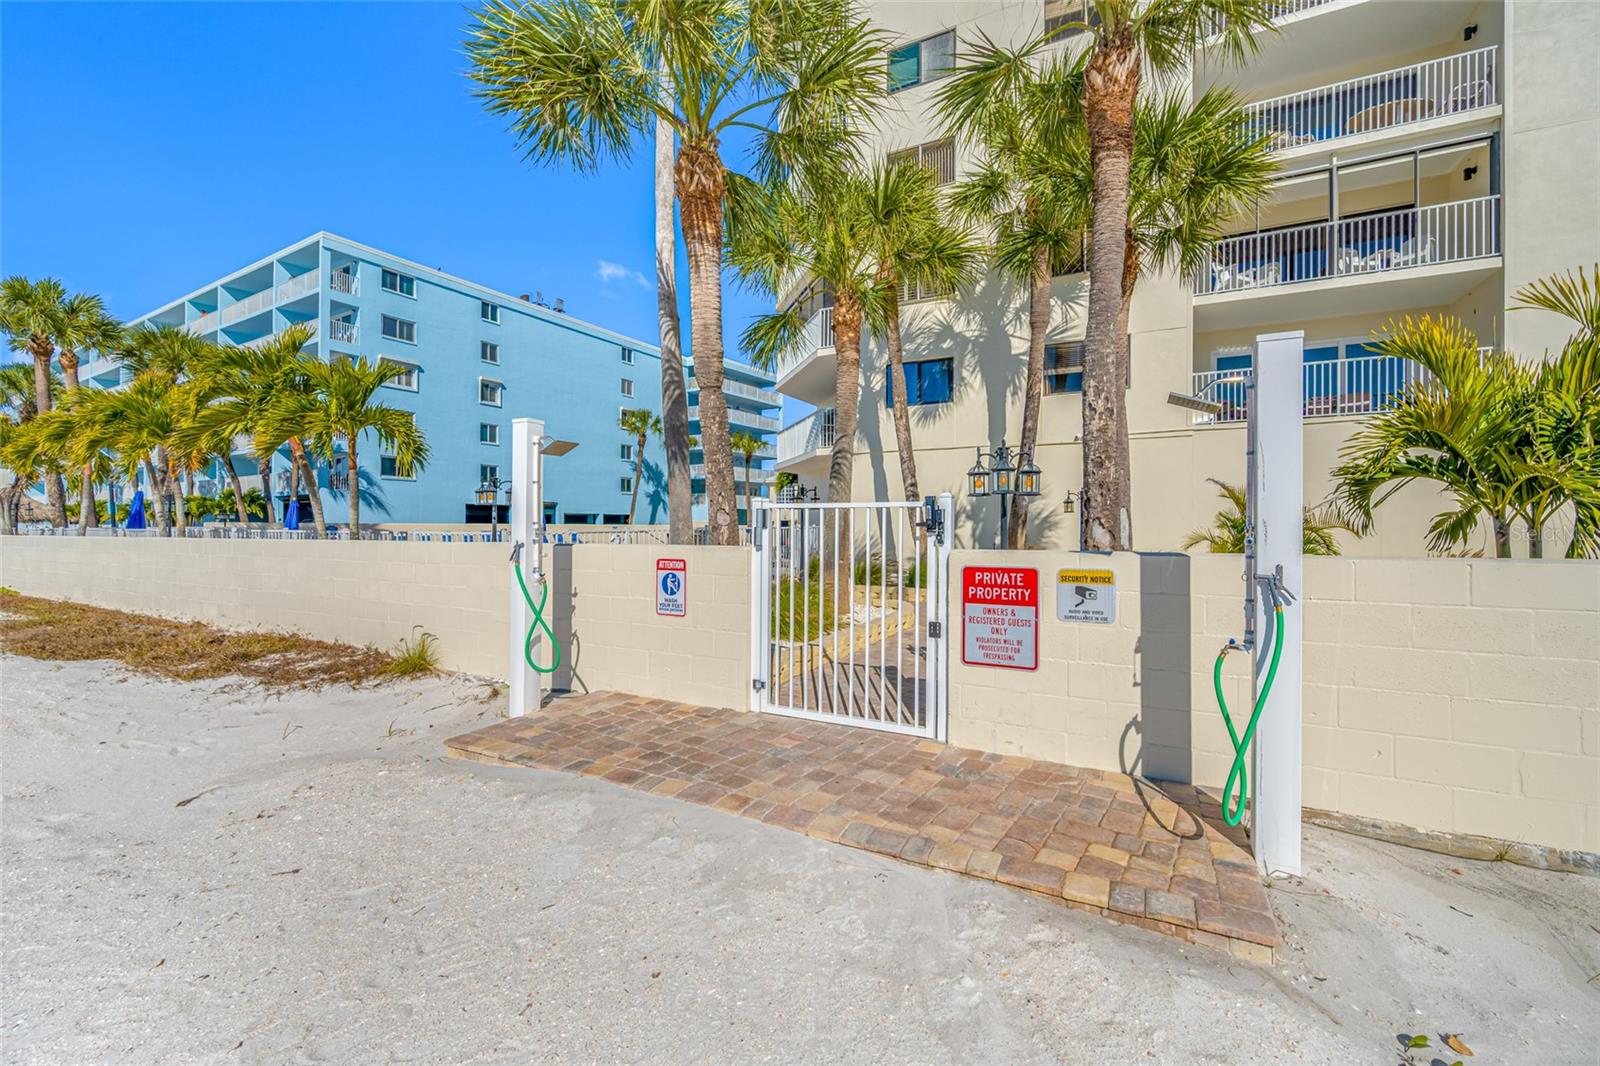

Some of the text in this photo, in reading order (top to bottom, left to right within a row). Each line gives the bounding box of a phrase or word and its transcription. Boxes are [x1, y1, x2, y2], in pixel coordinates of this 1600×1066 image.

[975, 572, 1024, 585] PRIVATE
[1061, 575, 1088, 583] SECURITY
[969, 587, 1031, 601] PROPERTY
[982, 607, 1016, 617] OWNERS &
[969, 616, 1032, 627] REGISTERED GUESTS
[990, 627, 1007, 635] ONLY
[978, 644, 1009, 653] PROSECUTED
[983, 653, 1015, 661] TRESPASSING
